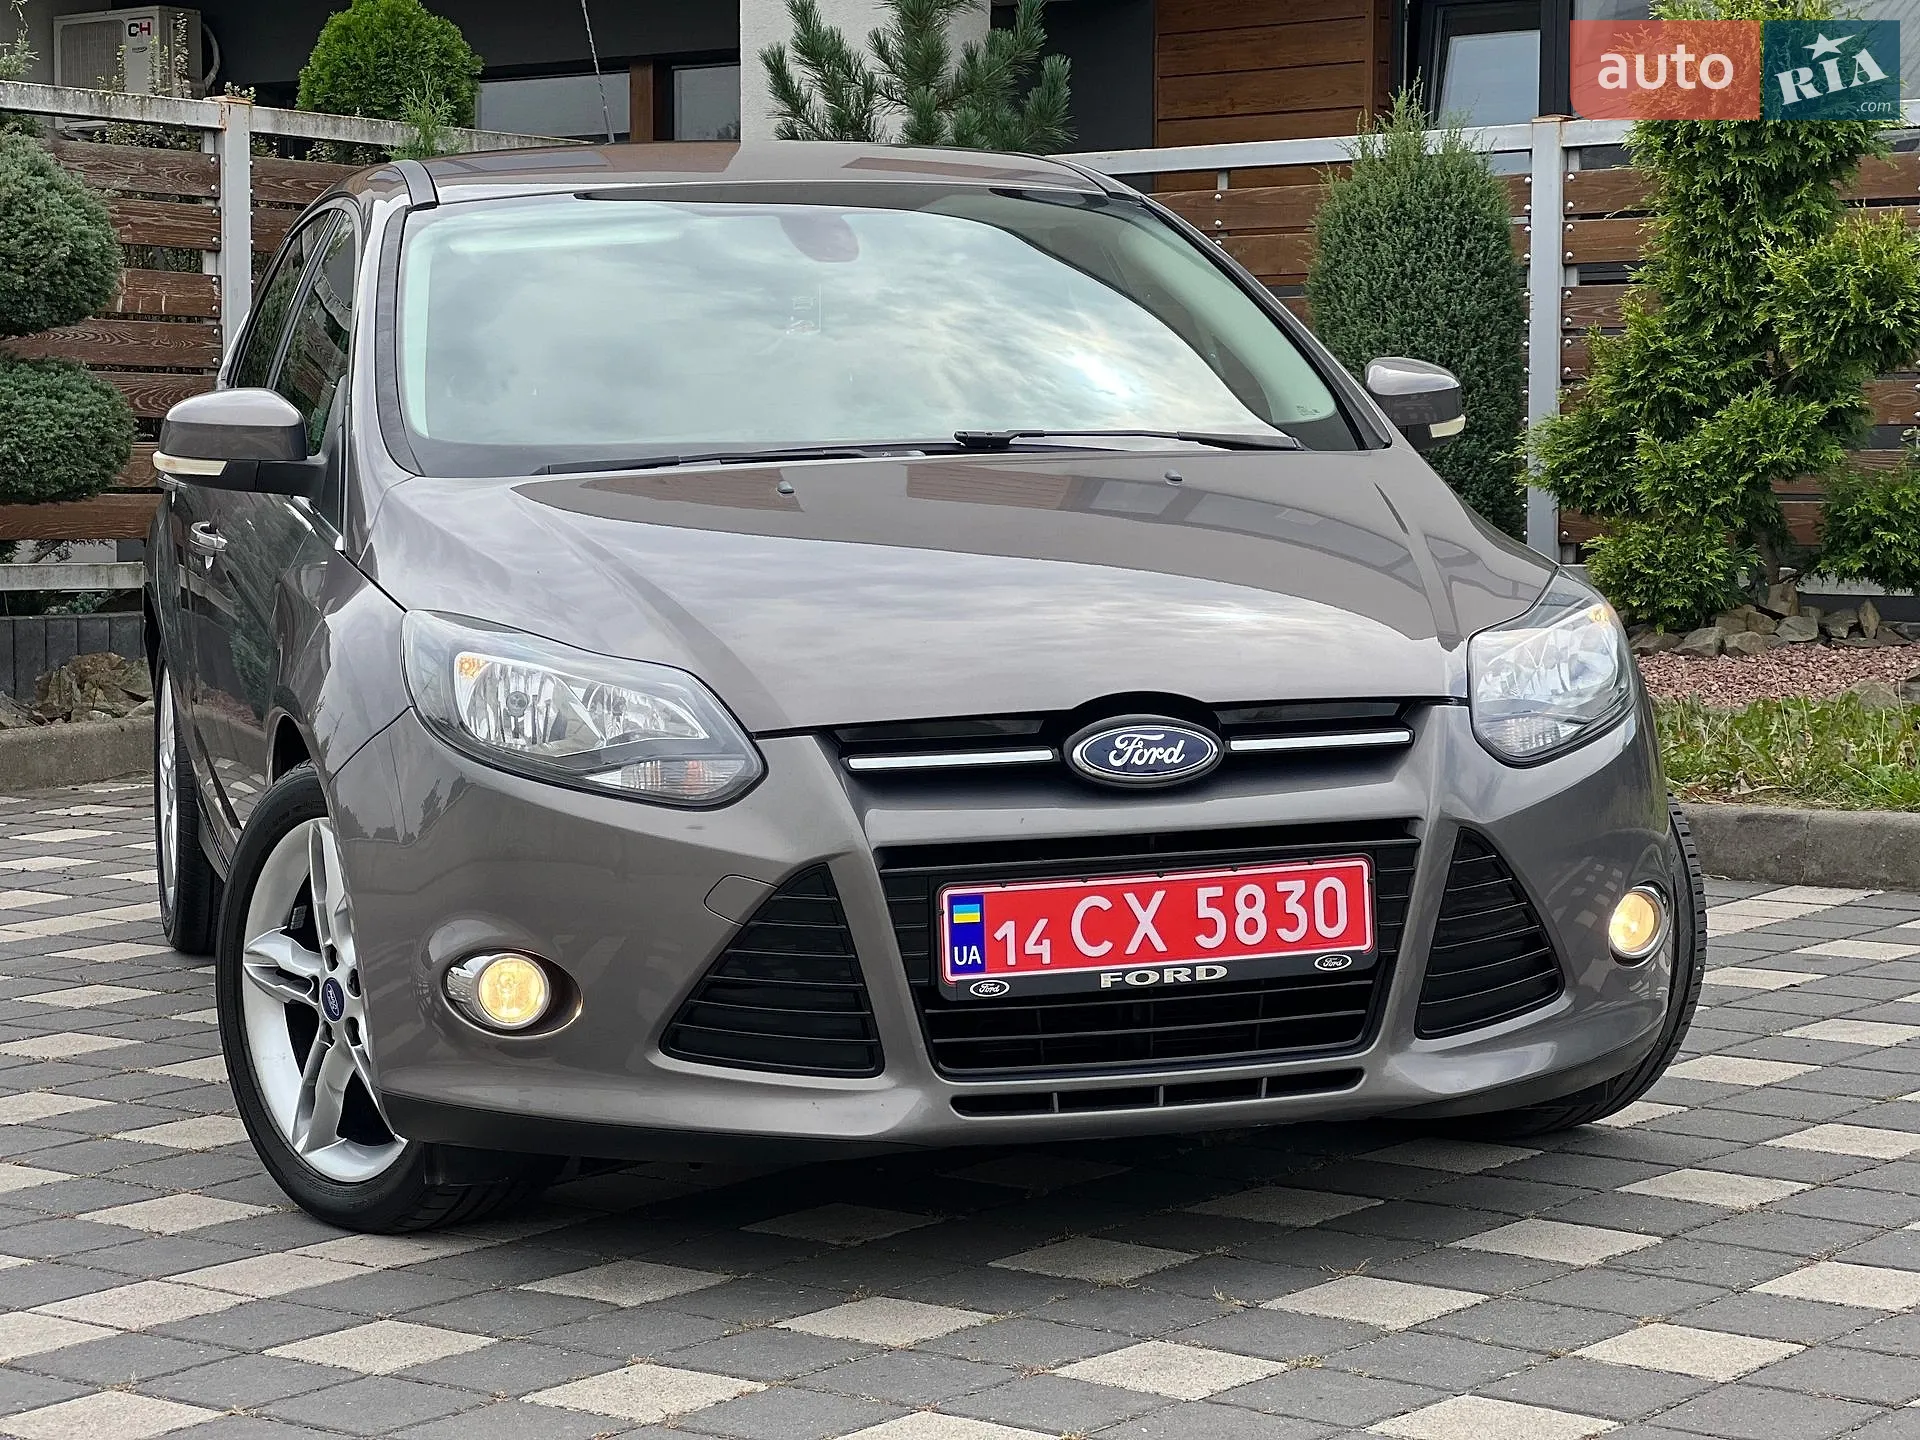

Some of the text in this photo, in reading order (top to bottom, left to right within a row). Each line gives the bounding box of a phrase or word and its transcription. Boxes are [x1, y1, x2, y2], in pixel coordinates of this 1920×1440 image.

[127, 21, 151, 37] CH
[1109, 733, 1186, 767] Ford
[993, 876, 1348, 966] 14 CX 5830
[953, 945, 982, 966] UA
[1322, 957, 1343, 967] Ford
[1100, 964, 1228, 988] FORD
[978, 983, 1000, 993] Ford
